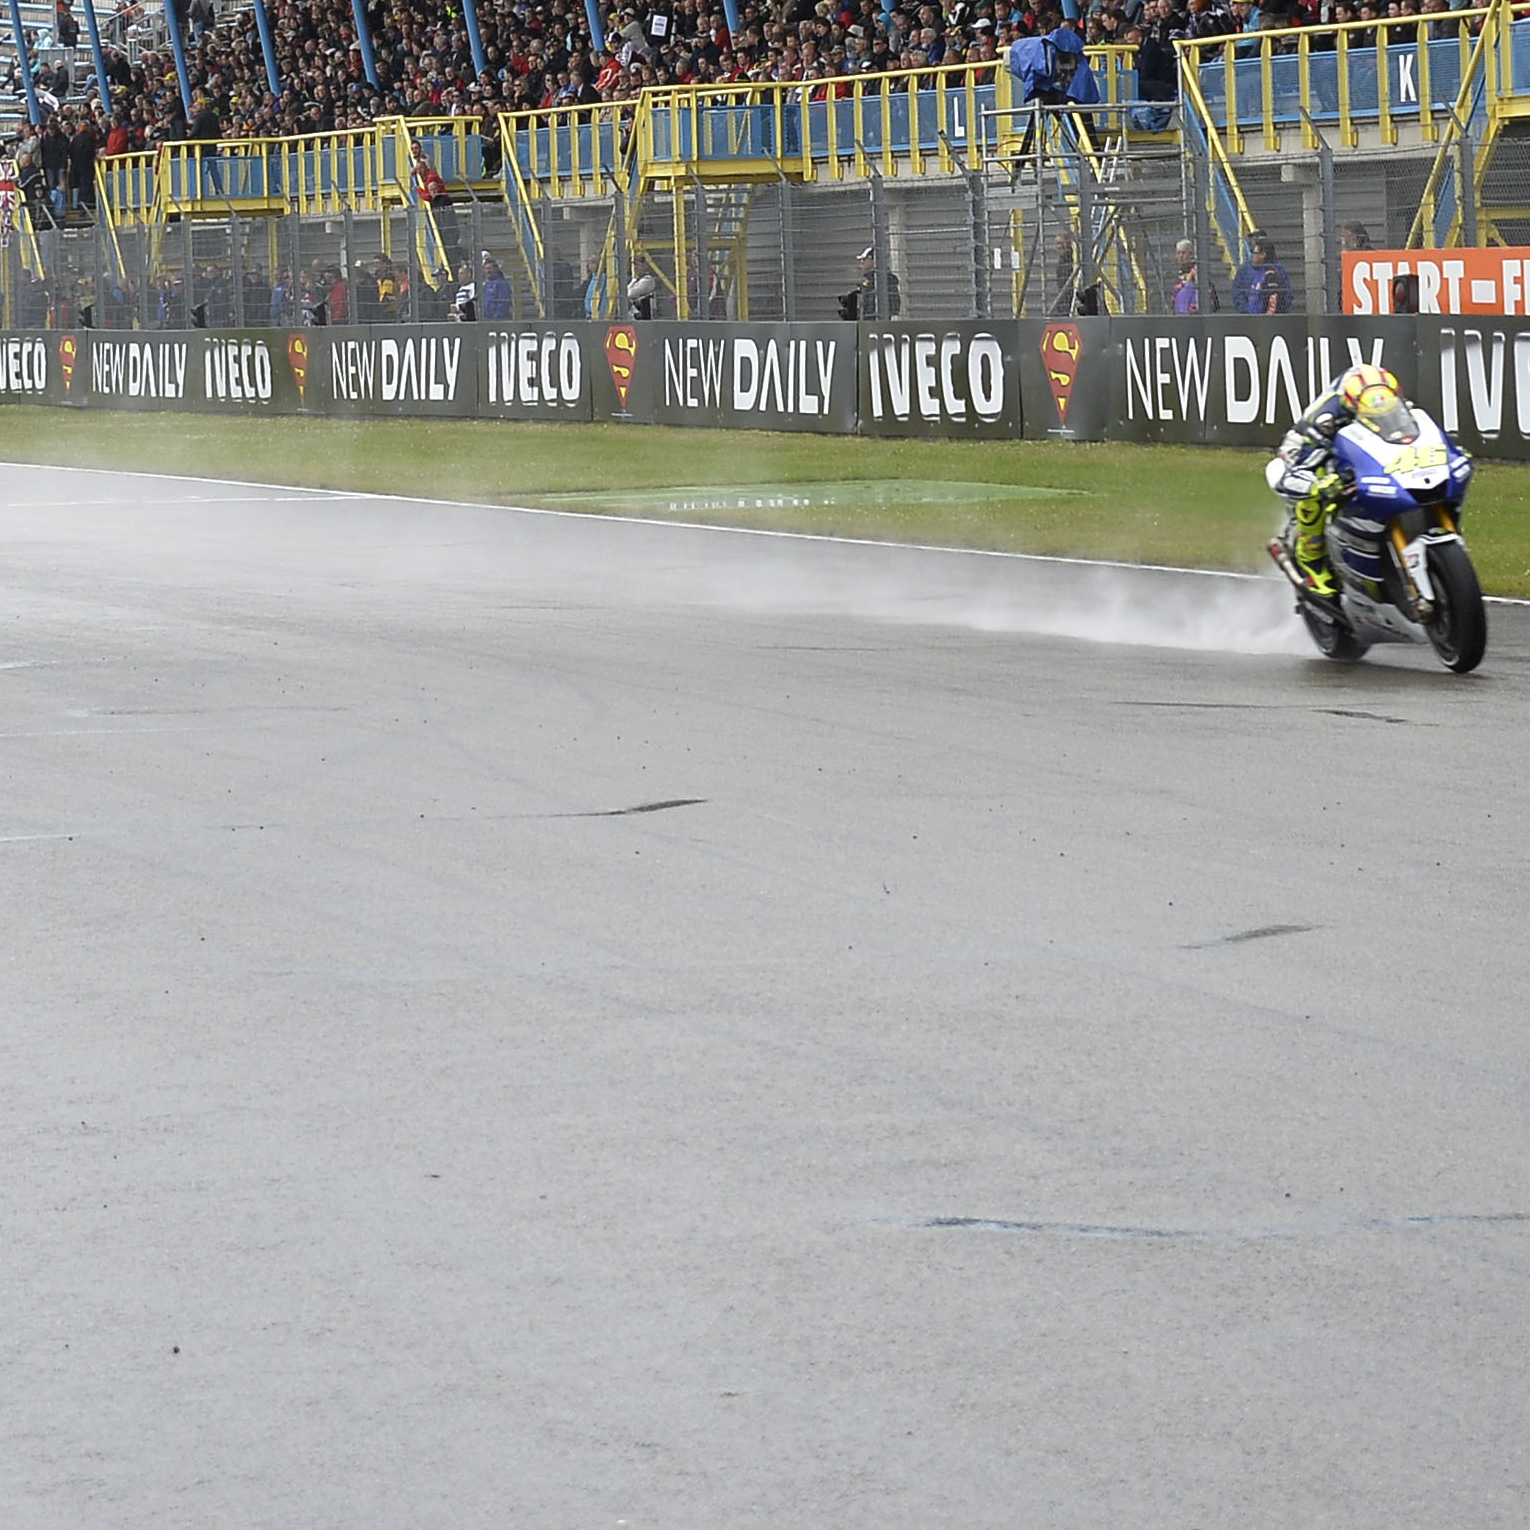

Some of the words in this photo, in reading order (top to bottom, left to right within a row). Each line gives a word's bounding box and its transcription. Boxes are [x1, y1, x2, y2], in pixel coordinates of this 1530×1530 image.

[1398, 53, 1416, 104] K
[953, 96, 965, 138] L
[92, 341, 126, 395] NEW
[128, 342, 187, 398] DAILY
[204, 337, 272, 405] IVECO
[331, 339, 376, 401] NEW
[381, 337, 461, 402] DAILY
[488, 331, 581, 408] IVECO
[663, 337, 725, 410] NEW
[732, 337, 837, 415] DAILY
[869, 331, 1004, 423] IVECO
[1124, 335, 1213, 423] NEW
[1383, 443, 1448, 475] 46
